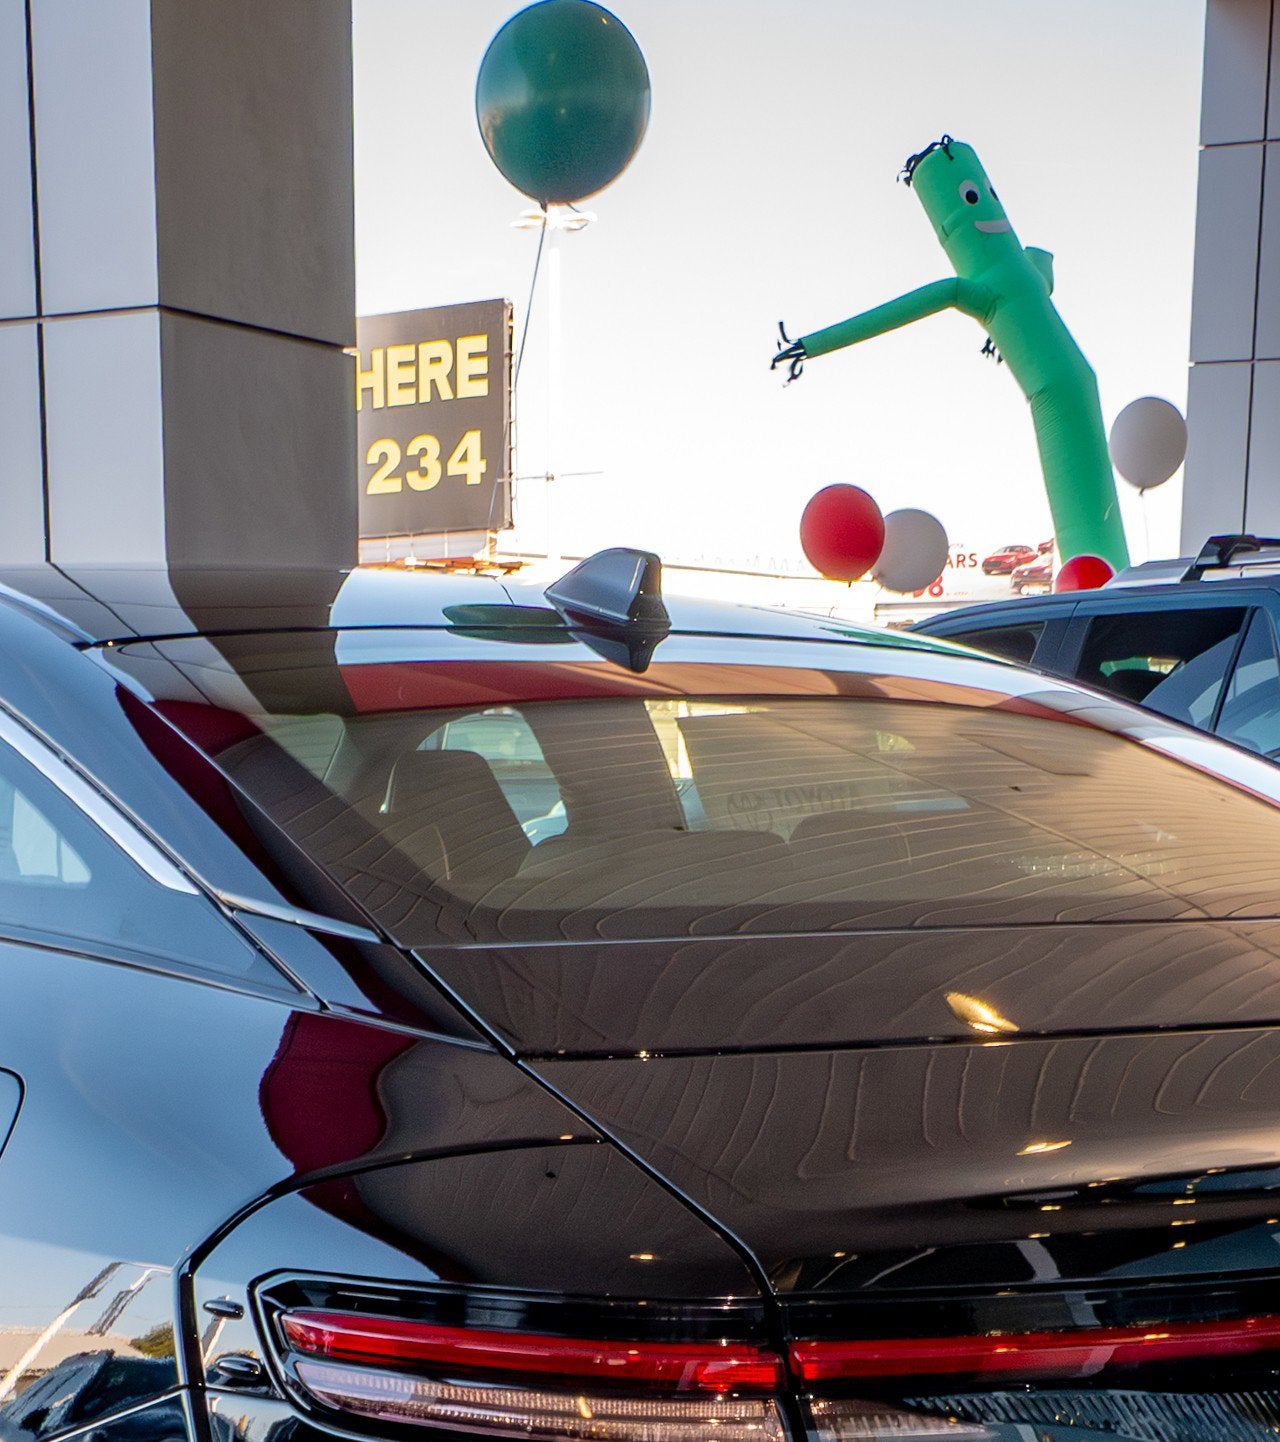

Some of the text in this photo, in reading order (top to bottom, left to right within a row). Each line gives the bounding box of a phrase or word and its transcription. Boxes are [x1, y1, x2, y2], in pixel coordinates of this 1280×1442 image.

[356, 334, 489, 411] HERE
[366, 429, 487, 495] 234
[946, 552, 978, 568] ARS
